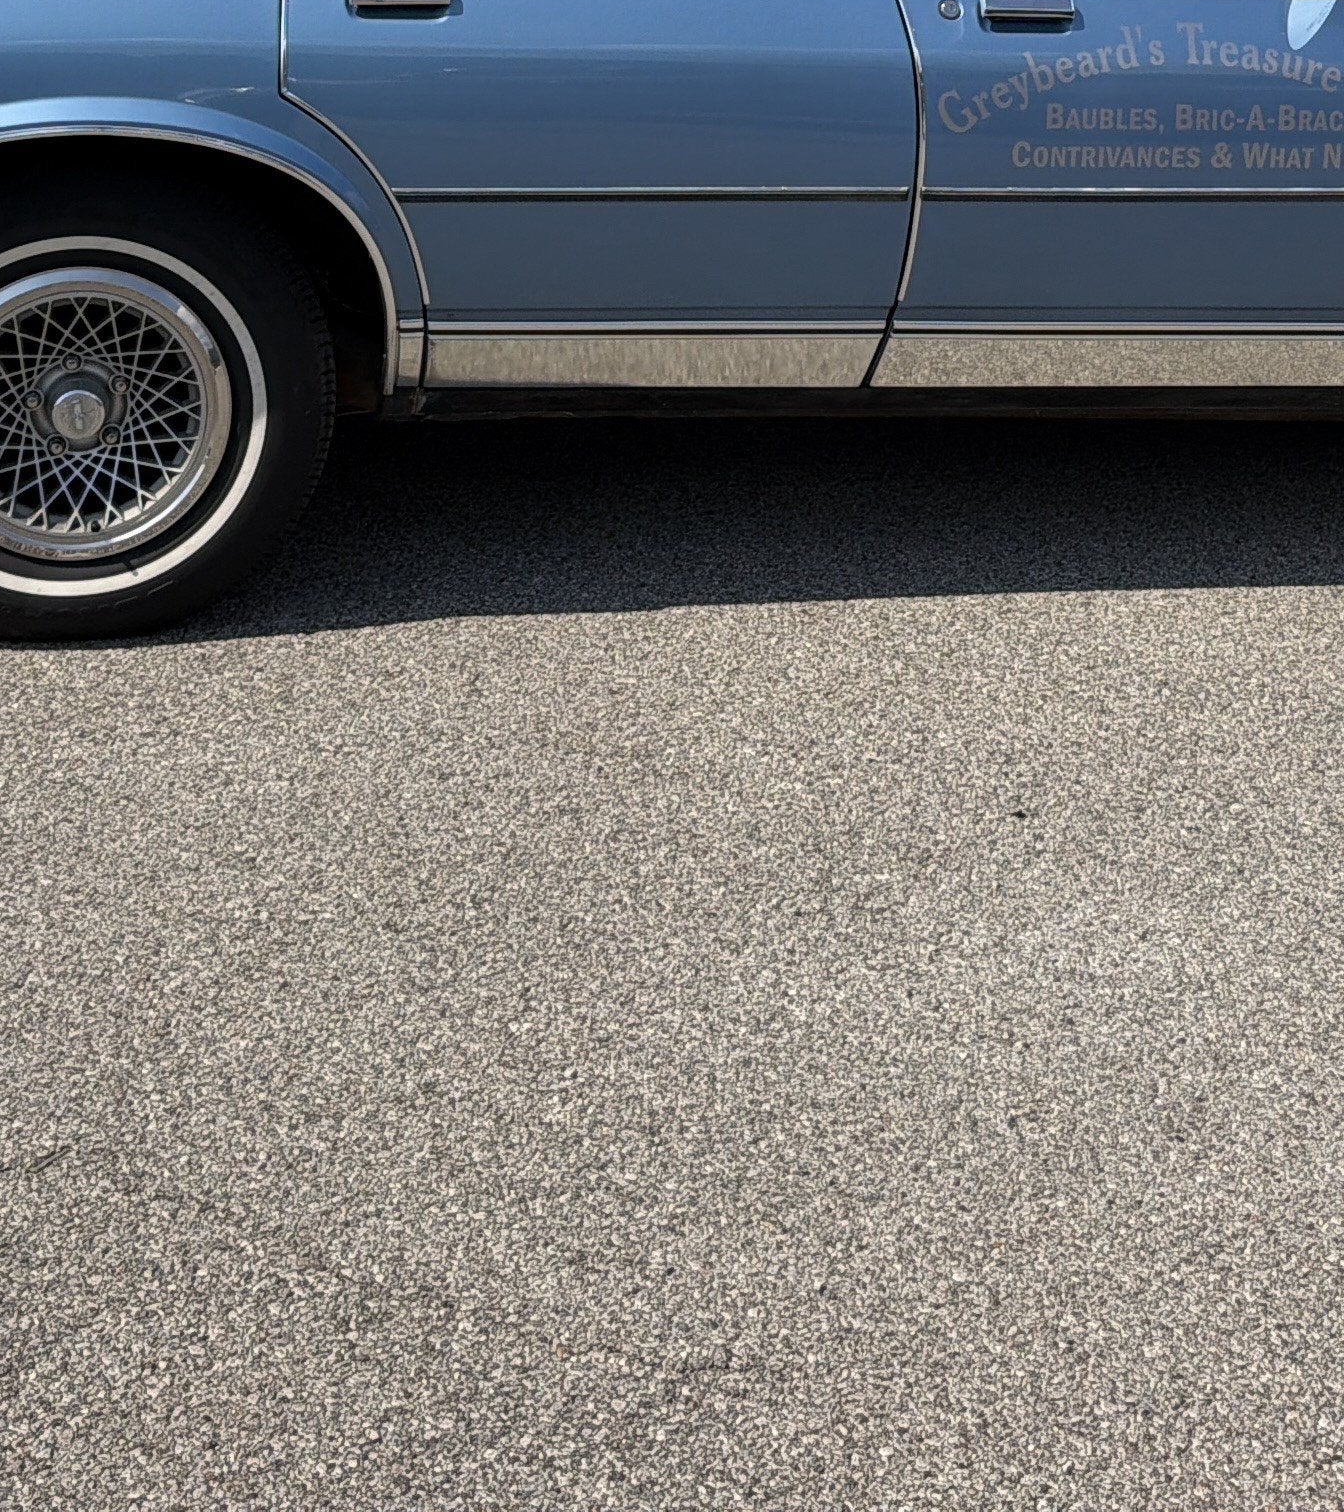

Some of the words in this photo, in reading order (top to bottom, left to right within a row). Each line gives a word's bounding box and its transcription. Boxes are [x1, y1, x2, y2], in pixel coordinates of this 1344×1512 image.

[937, 25, 1166, 134] Greybeard's
[1177, 22, 1342, 93] Treasure
[1046, 103, 1165, 135] BAUBLES,
[1175, 103, 1344, 132] BRIC-A-BRAC
[1011, 140, 1202, 169] CONTRIVANCES
[1210, 141, 1233, 169] &
[1242, 142, 1315, 169] WHAT
